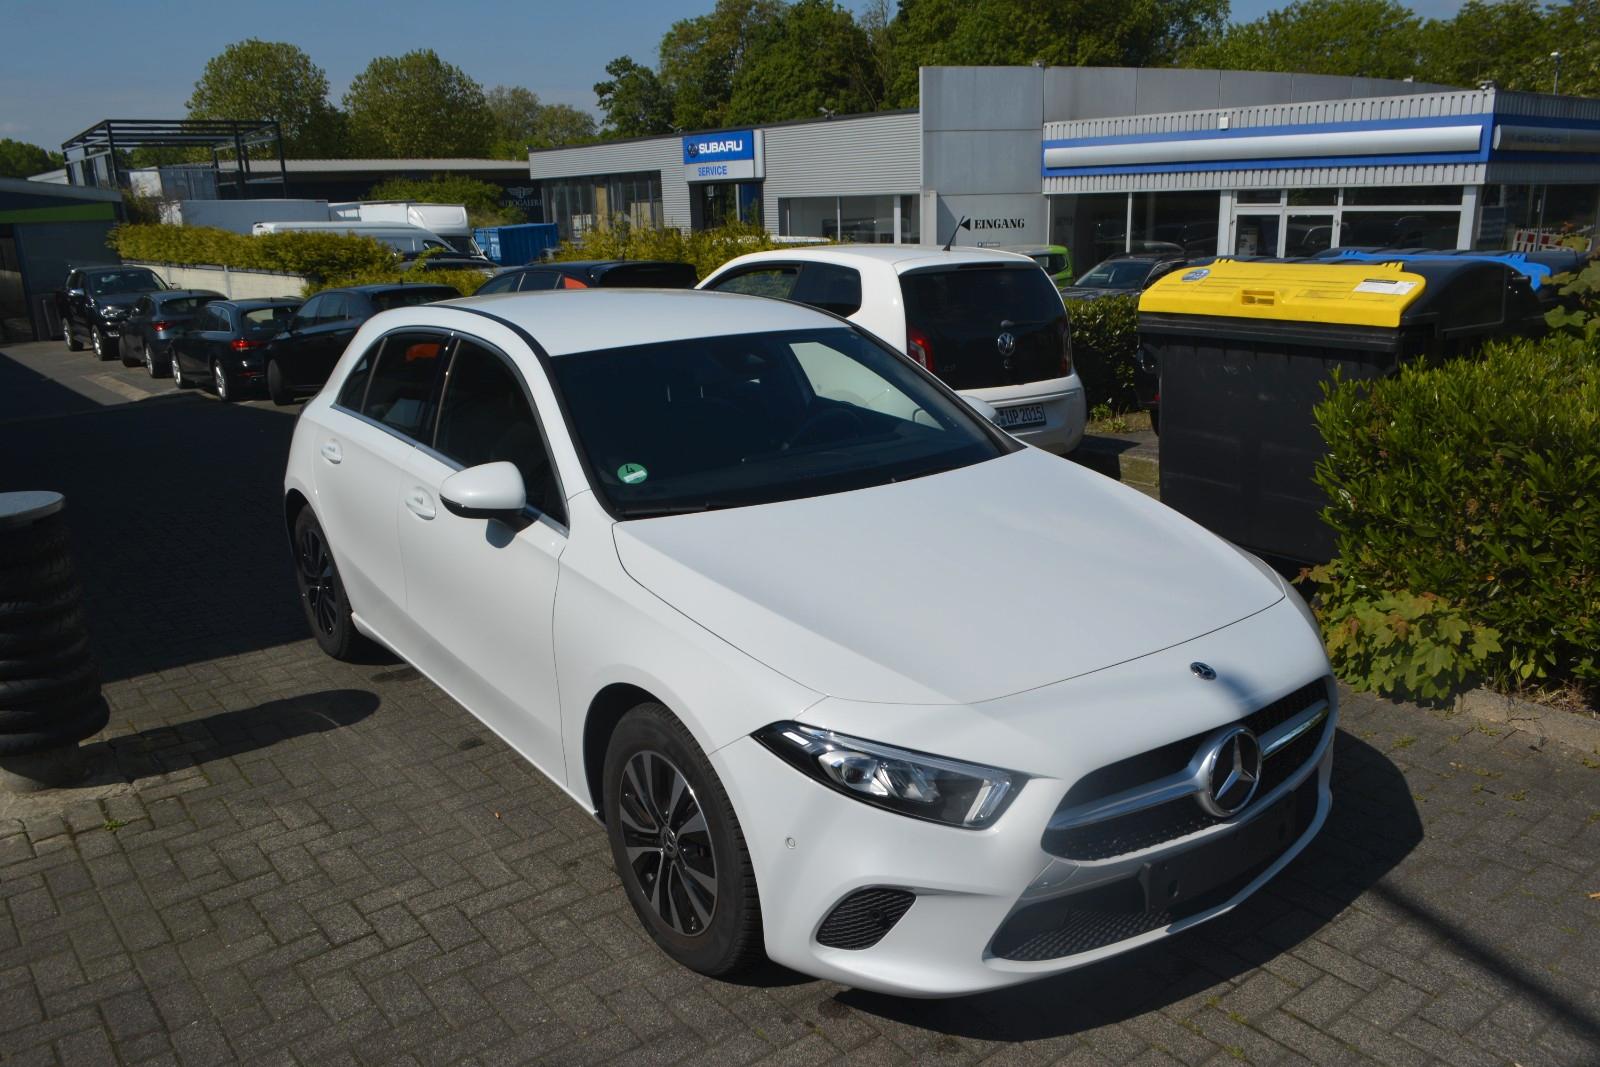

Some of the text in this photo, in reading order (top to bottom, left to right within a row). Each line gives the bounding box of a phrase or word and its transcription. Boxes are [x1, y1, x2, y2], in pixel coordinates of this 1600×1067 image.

[699, 140, 742, 154] SUBARU
[698, 165, 727, 177] SERVICE
[974, 218, 1025, 230] EINGANG
[1005, 406, 1043, 424] UP 2015
